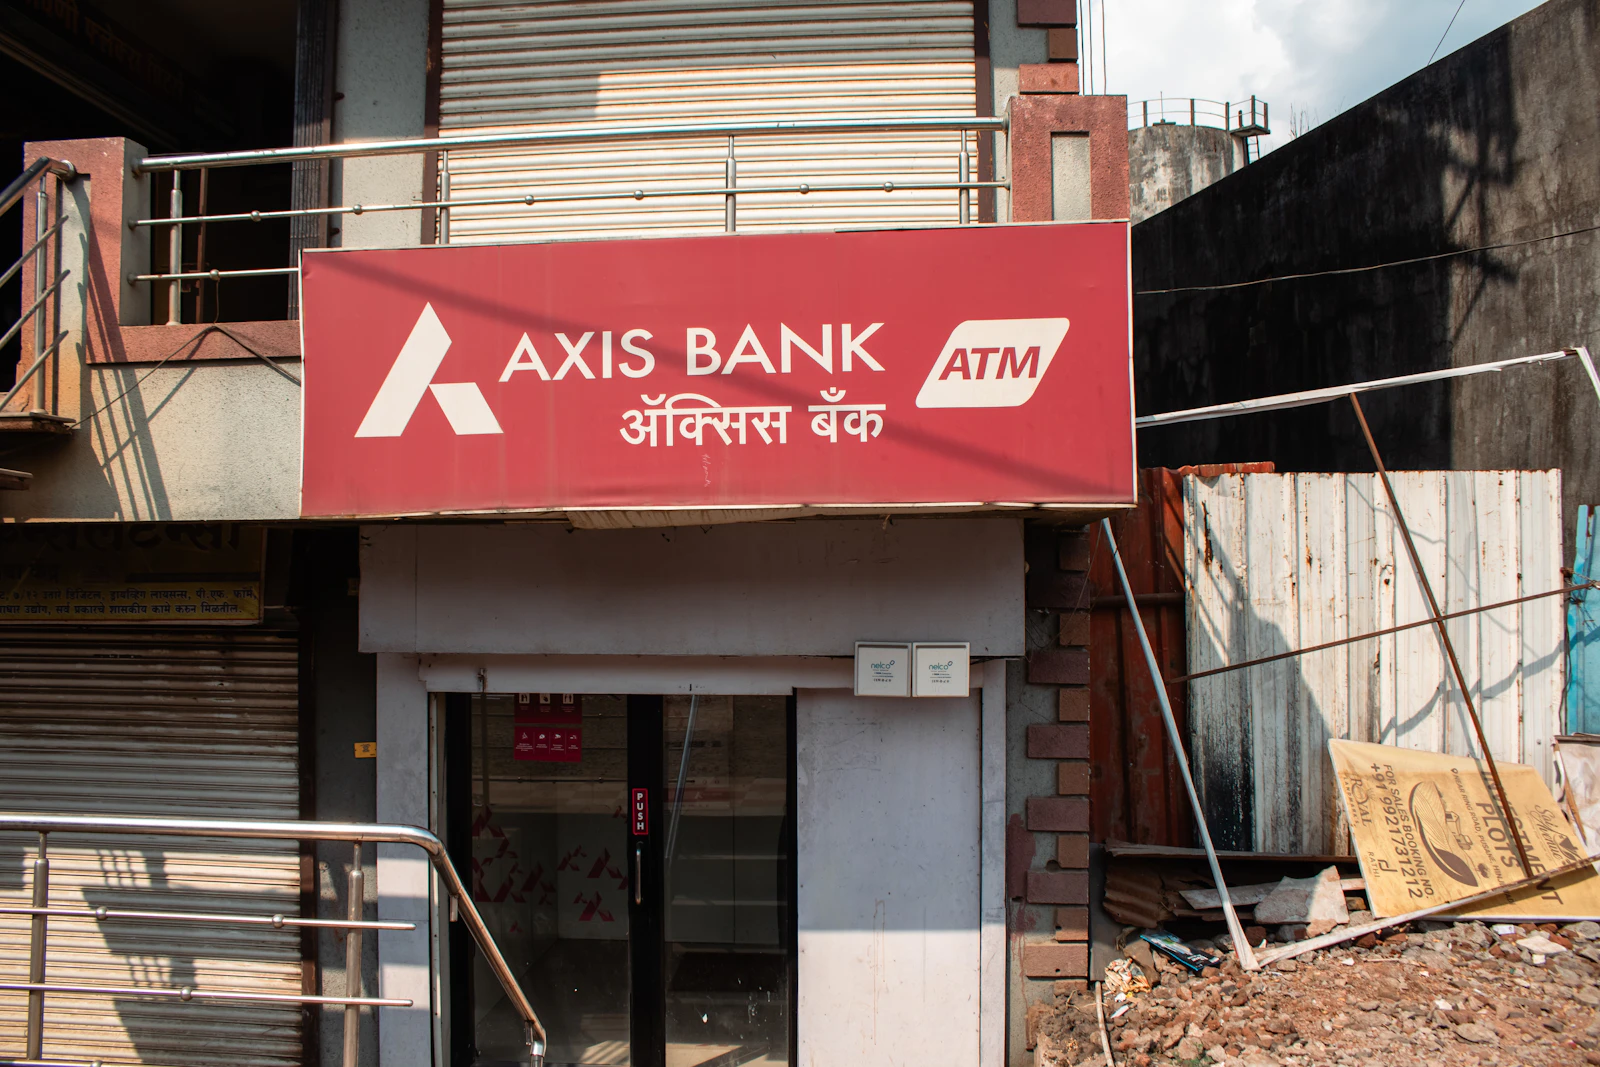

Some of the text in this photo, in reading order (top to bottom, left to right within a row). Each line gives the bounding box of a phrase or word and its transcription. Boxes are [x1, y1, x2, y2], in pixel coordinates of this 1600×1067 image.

[499, 322, 886, 383] AXIS BANK
[938, 346, 1040, 380] ATM
[807, 386, 887, 443] बँक
[55, 601, 70, 614] सर्व
[74, 601, 106, 614] प्रकारचे
[109, 601, 147, 614] शासकीय
[151, 601, 171, 614] कामे
[870, 661, 891, 670] nelco
[928, 662, 948, 671] nelco
[636, 792, 645, 831] PUSH
[1350, 777, 1372, 827] ROYAL
[1453, 774, 1465, 794] NEAR
[1461, 793, 1473, 812] RING
[1371, 763, 1424, 899] +91 9921731212
[1383, 764, 1435, 900] FOR SALES BOOKING NO.
[1476, 802, 1520, 869] PLOTS
[1367, 851, 1380, 878] RATHI
